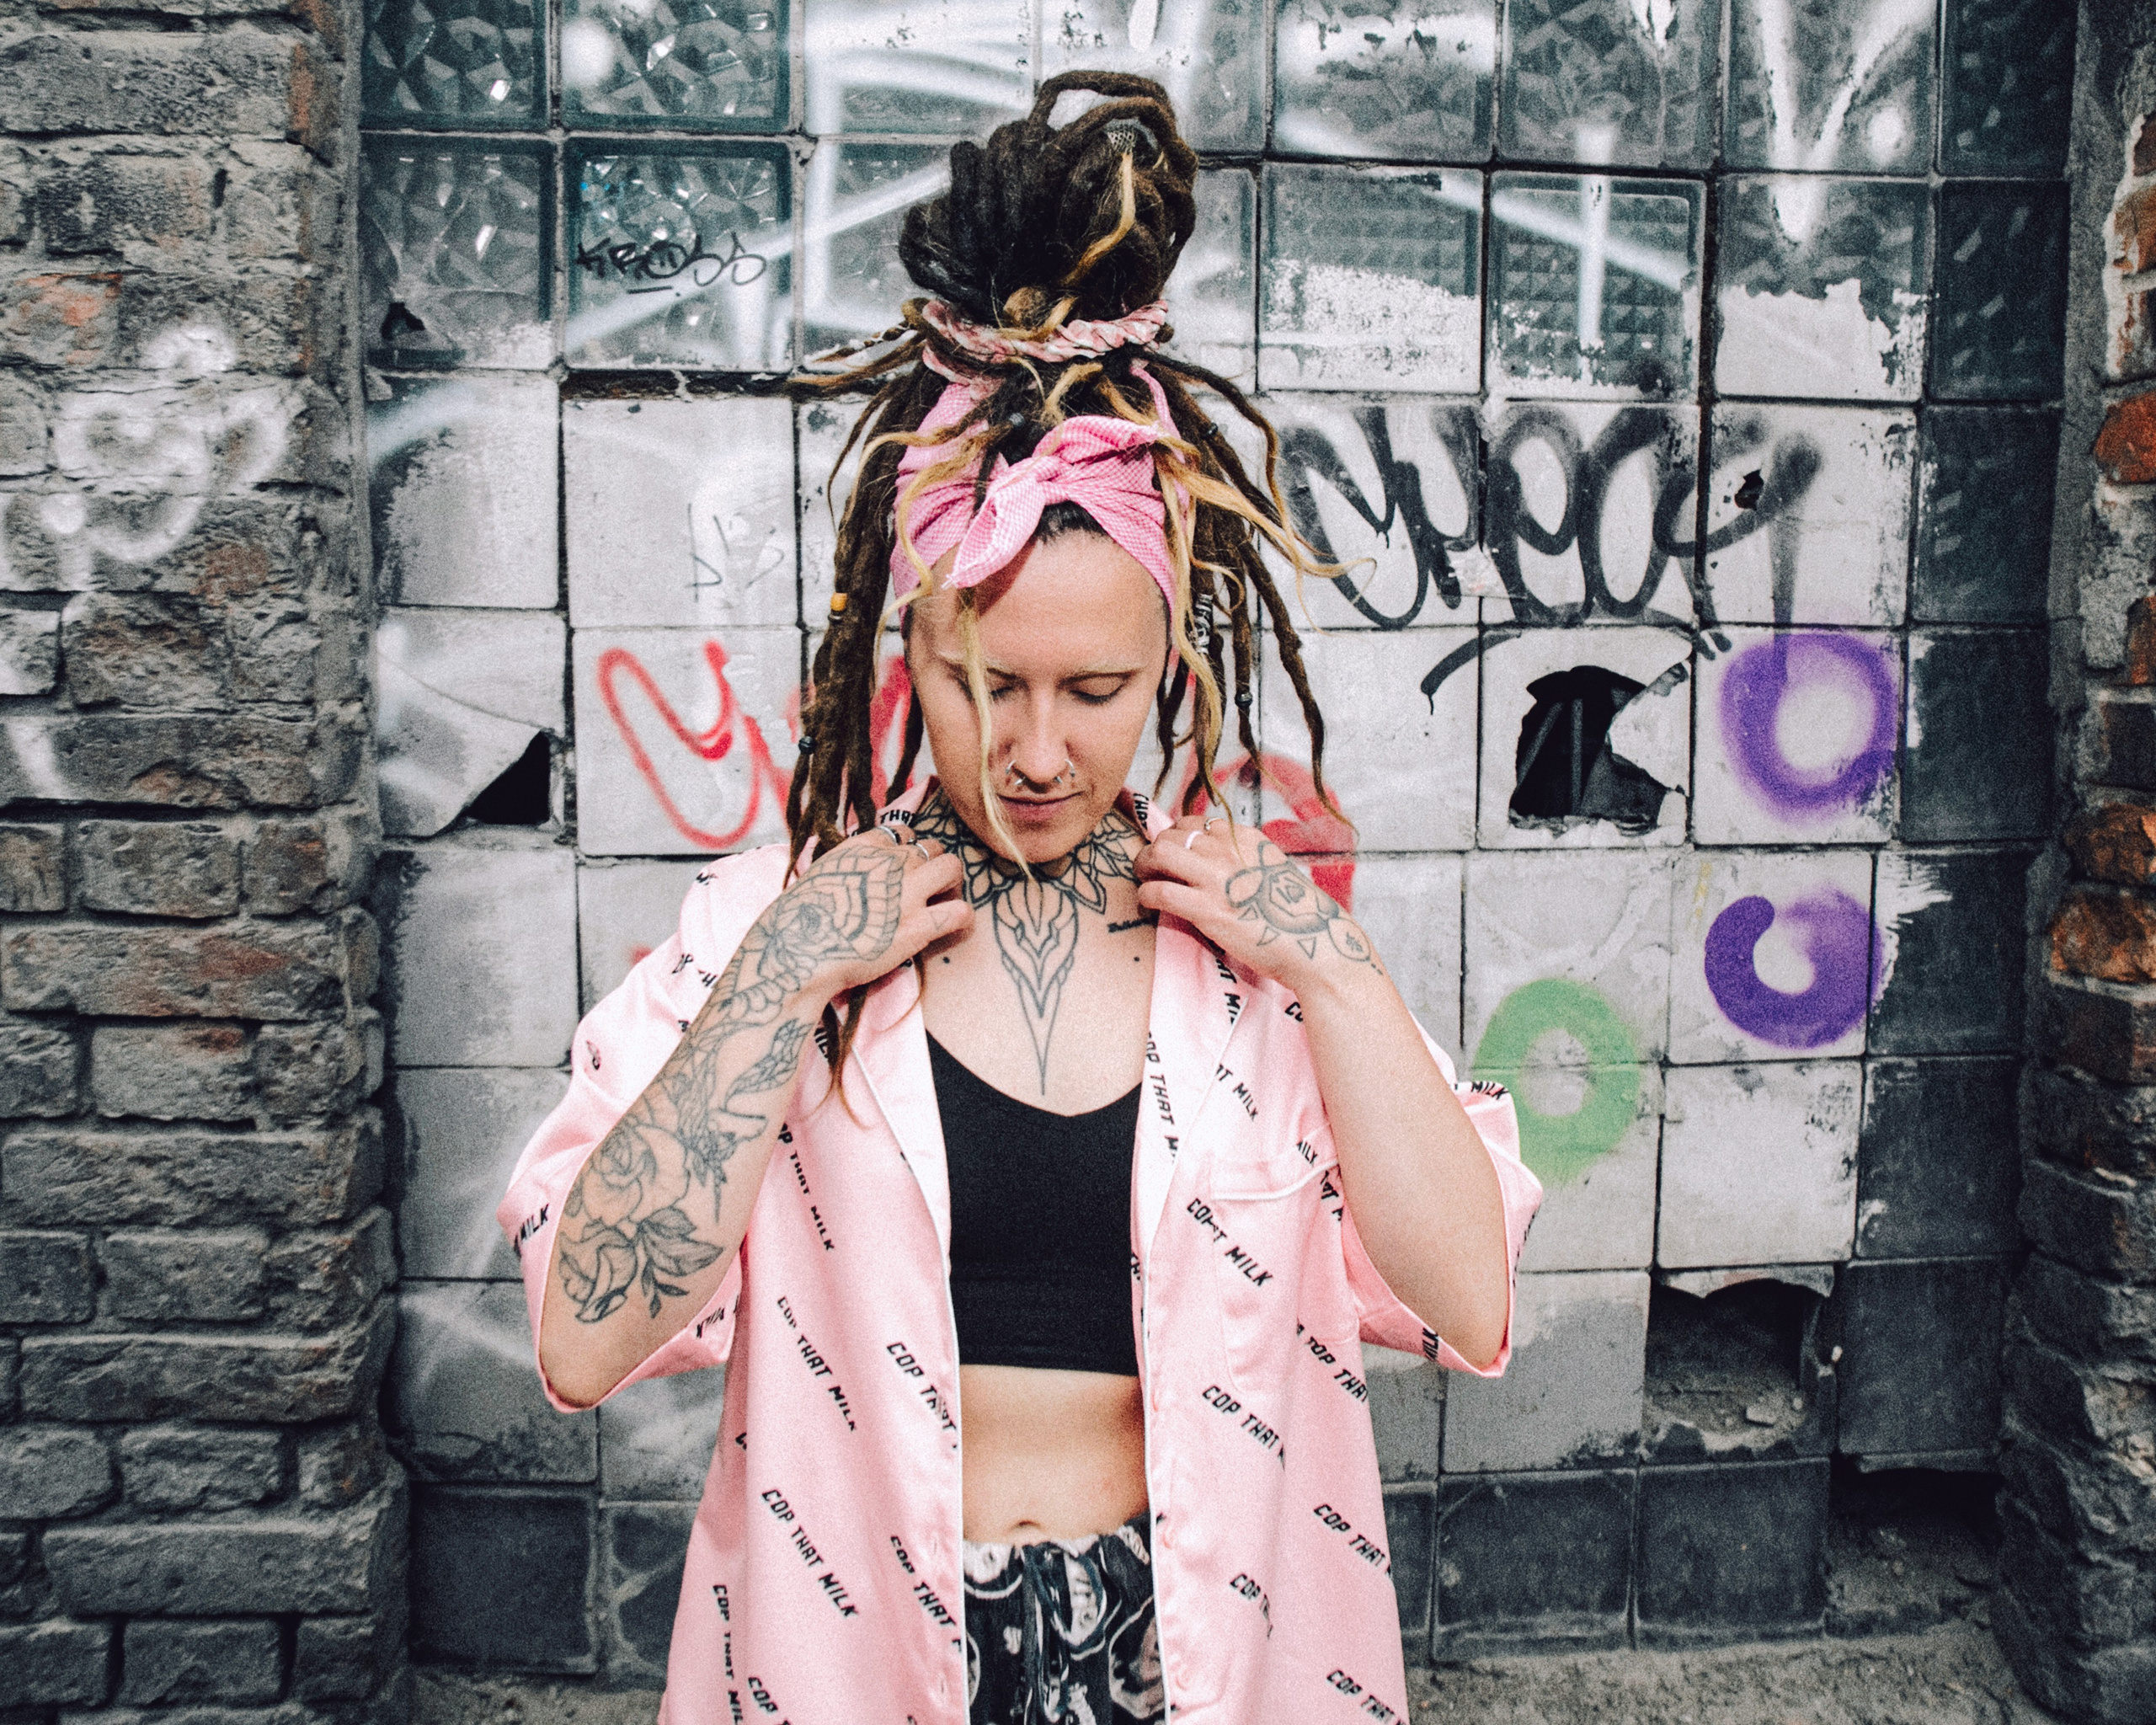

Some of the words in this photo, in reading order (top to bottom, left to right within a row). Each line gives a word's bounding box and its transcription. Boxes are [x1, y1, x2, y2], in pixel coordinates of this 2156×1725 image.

[1150, 1075, 1175, 1125] THAT
[1233, 1082, 1258, 1121] MILK
[1470, 1081, 1509, 1100] MILK
[1225, 1246, 1273, 1286] MILK
[797, 1334, 833, 1376] THAT
[887, 1342, 925, 1377] COP
[1203, 1386, 1241, 1413] COP
[1241, 1413, 1279, 1449] THAT
[761, 1489, 795, 1521] COP
[791, 1525, 825, 1567] THAT
[819, 1573, 859, 1616] MILK
[1313, 1503, 1351, 1531] COP
[1349, 1534, 1386, 1567] THAT
[890, 1535, 915, 1573] COP
[914, 1582, 957, 1626] THAT
[1230, 1573, 1261, 1599] COP
[712, 1584, 729, 1621] COP
[748, 1676, 779, 1713] COP
[1326, 1669, 1363, 1694] COP
